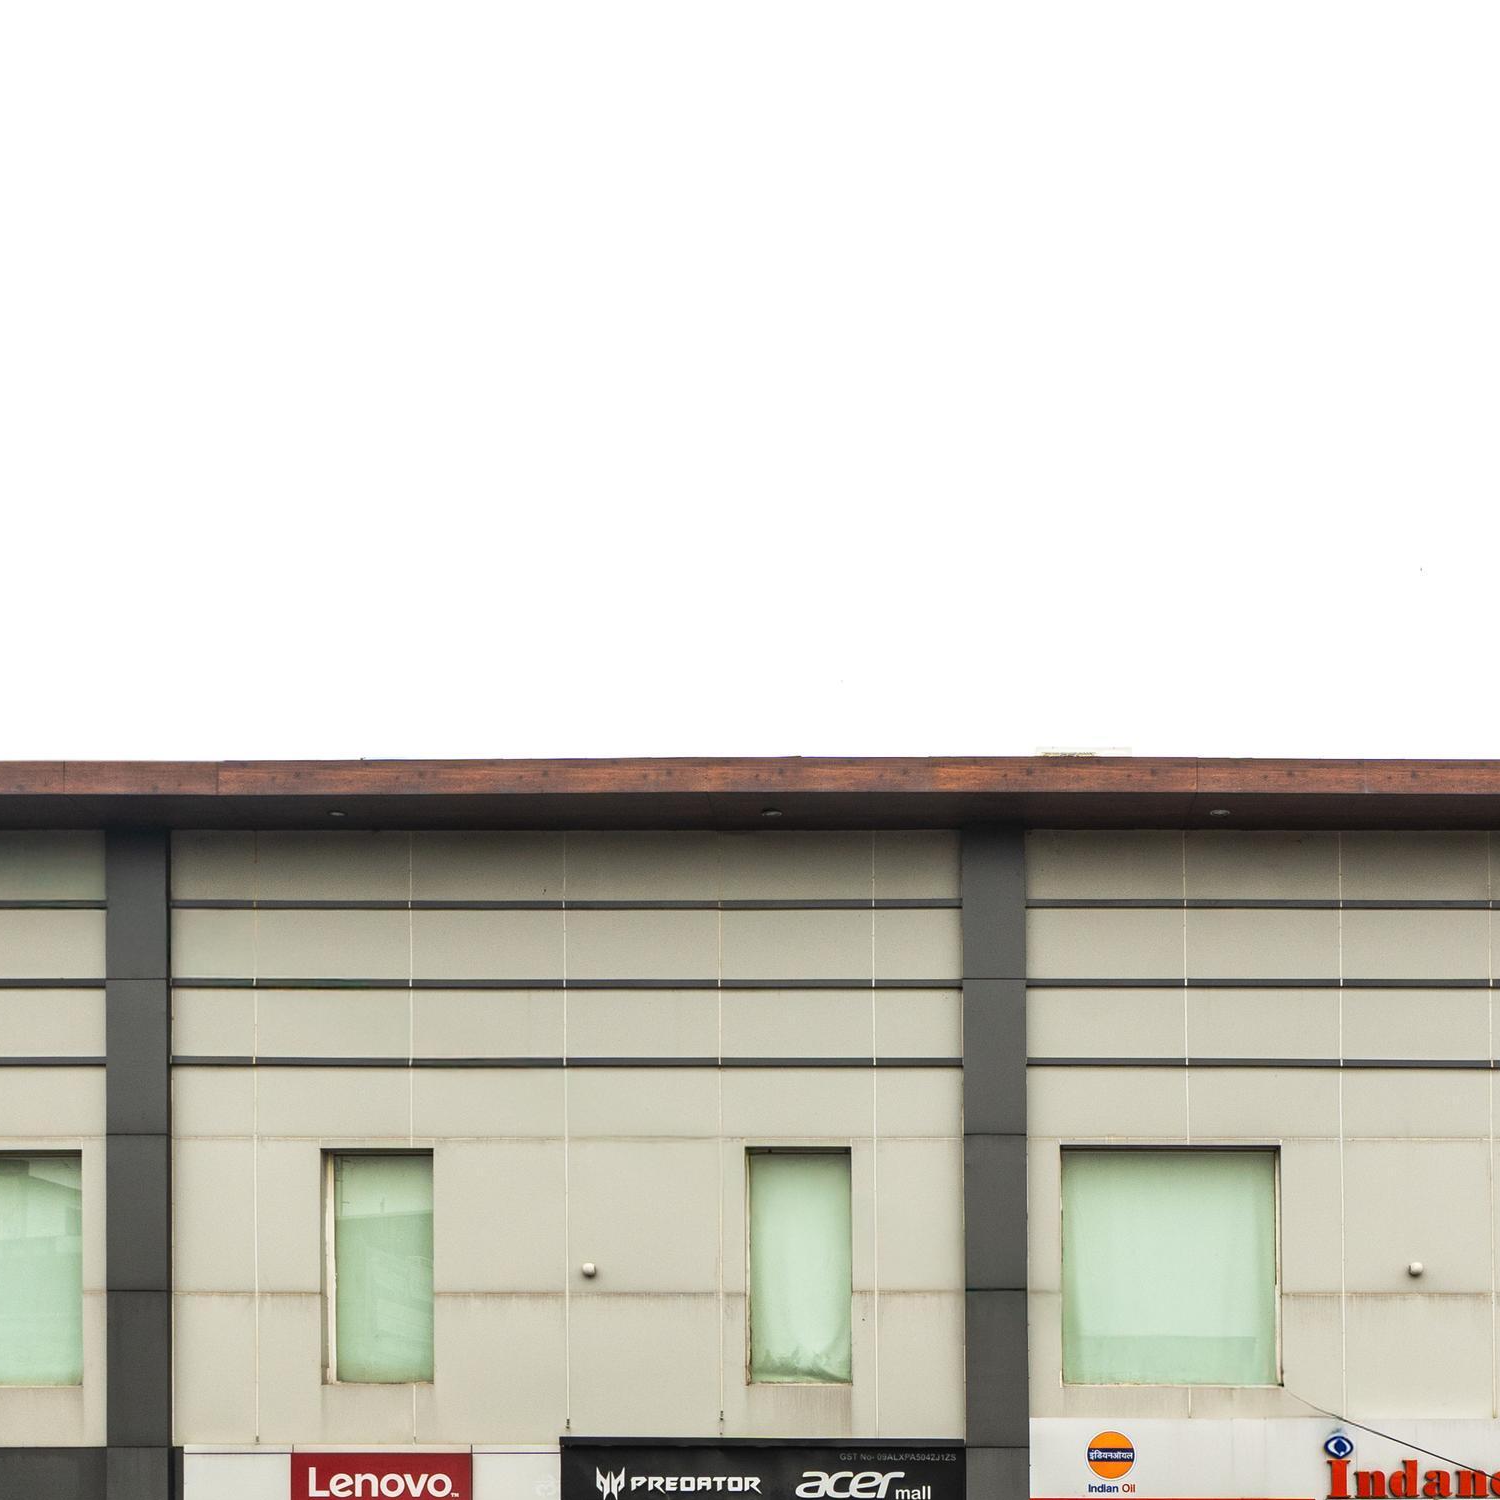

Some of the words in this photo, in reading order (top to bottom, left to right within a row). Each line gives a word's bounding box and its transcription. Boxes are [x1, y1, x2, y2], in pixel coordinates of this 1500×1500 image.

[840, 1453, 857, 1461] GST
[308, 1466, 453, 1498] Lenovo
[631, 1476, 761, 1494] PREDATOR
[795, 1471, 906, 1499] acer
[895, 1486, 931, 1500] mall
[1088, 1484, 1119, 1493] Indian
[1121, 1484, 1136, 1493] Oil
